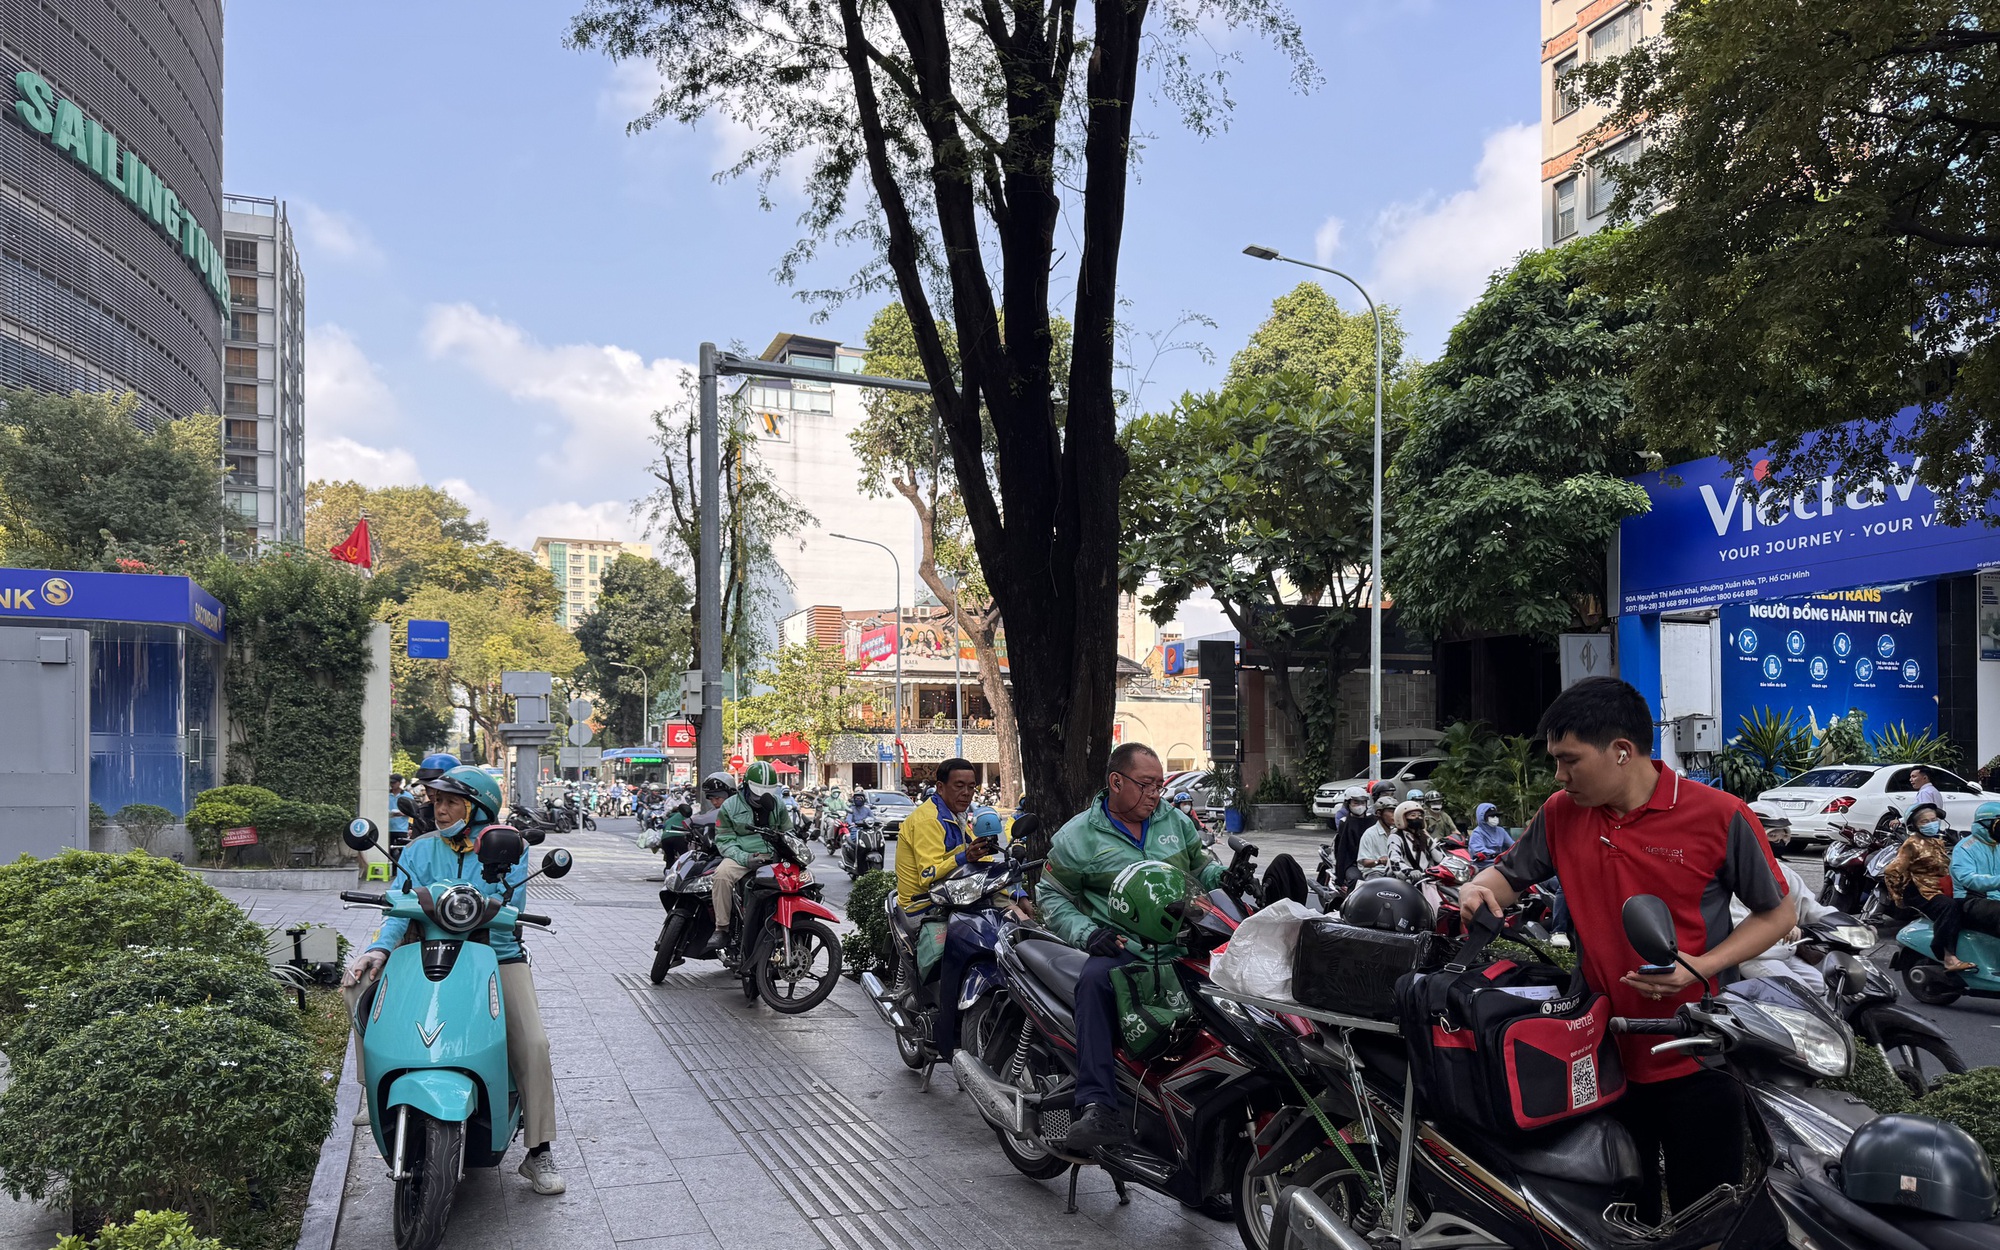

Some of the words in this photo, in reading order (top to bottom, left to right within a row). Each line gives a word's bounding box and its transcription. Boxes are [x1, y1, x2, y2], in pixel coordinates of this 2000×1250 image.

[16, 71, 180, 242] SAILING
[1719, 544, 1760, 562] YOUR
[1765, 529, 1843, 555] JOURNEY
[1862, 518, 1914, 537] YOUR
[1625, 595, 1637, 603] 90A
[1669, 588, 1683, 597] Minh
[1684, 586, 1699, 595] Khai,
[1757, 577, 1768, 585] TP.
[1780, 572, 1791, 581] Chí
[1792, 570, 1810, 580] Minh
[1658, 601, 1666, 609] 38
[1666, 599, 1677, 607] 668
[1678, 597, 1689, 605] 999
[1692, 594, 1717, 604] Hotline:
[1717, 592, 1732, 601] 1800
[1732, 590, 1745, 599] 646
[1745, 588, 1758, 597] 888
[1750, 603, 1790, 619] NGƯỜI
[1793, 602, 1828, 620] ĐỒNG
[1832, 606, 1866, 623] HÀNH
[1868, 610, 1888, 624] TIN
[1890, 609, 1913, 627] CẬY
[675, 732, 690, 742] 5G
